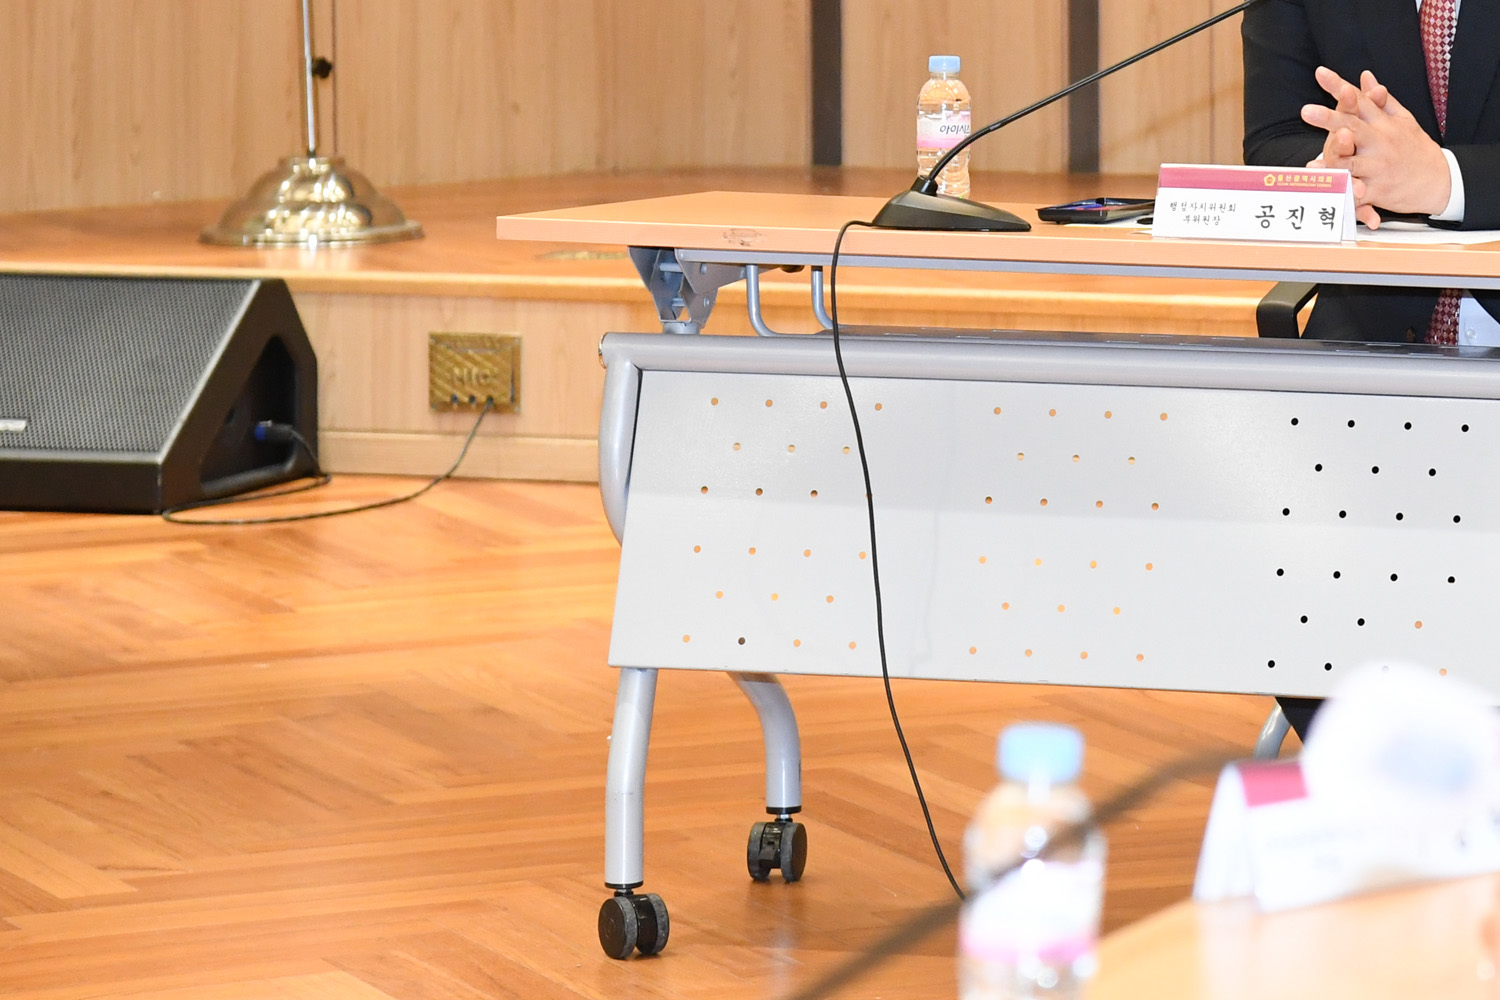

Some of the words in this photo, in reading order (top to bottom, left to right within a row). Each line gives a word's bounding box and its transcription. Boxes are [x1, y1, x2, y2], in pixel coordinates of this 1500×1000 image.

[1169, 201, 1236, 213] 행정자치위원회
[1182, 214, 1221, 226] 부위원장
[1254, 205, 1336, 231] 공진혁
